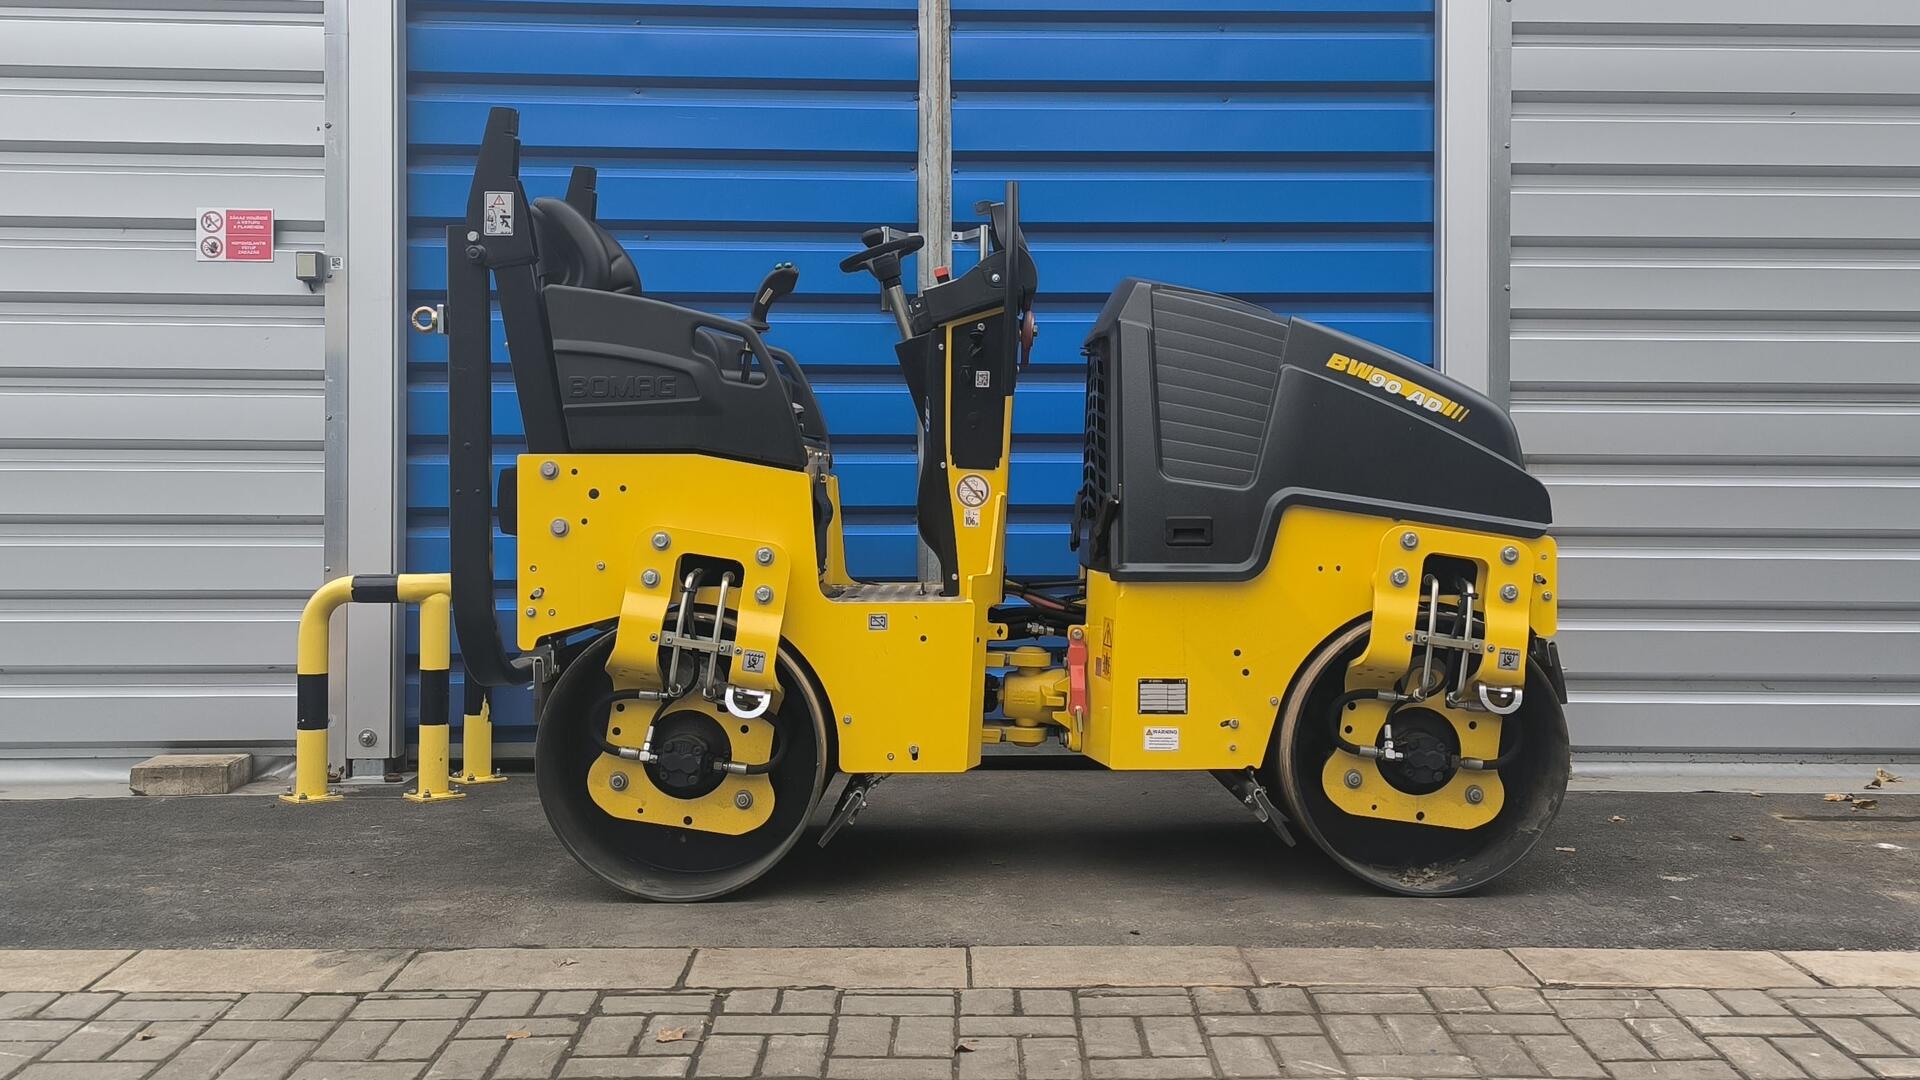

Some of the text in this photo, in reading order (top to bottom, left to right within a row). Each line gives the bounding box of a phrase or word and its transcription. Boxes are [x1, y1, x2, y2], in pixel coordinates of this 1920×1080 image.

[568, 376, 677, 399] BOMAG
[1405, 391, 1443, 412] AD
[965, 516, 975, 525] 106
